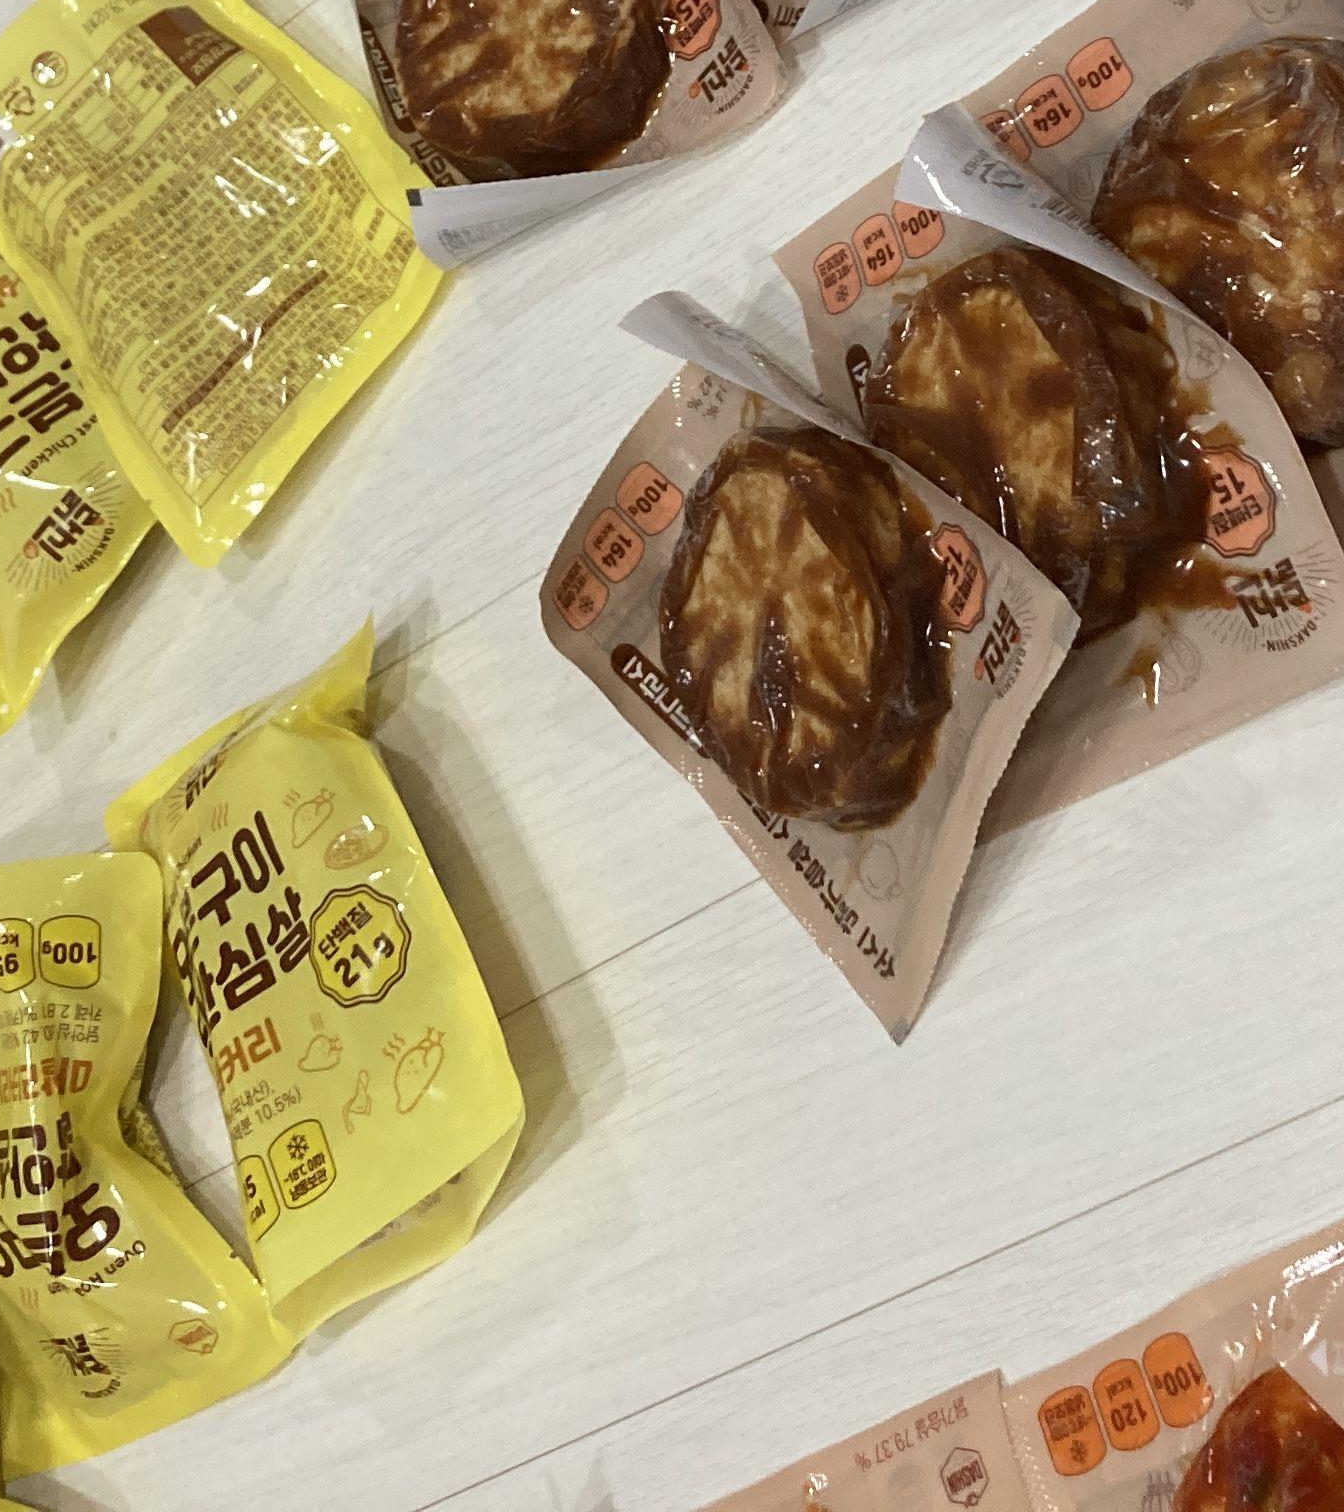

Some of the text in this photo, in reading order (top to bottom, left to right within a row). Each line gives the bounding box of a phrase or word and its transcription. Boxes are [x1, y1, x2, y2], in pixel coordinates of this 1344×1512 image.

[697, 35, 748, 103] 닭신
[1075, 53, 1124, 90] 100g
[1076, 54, 1122, 89] 100g
[1030, 100, 1073, 135] 164
[861, 227, 886, 250] kcal
[899, 207, 939, 235] 100g
[864, 242, 896, 272] 164
[18, 431, 77, 480] Chicken
[626, 475, 670, 517] 100g
[1206, 494, 1262, 536] 단백질
[29, 486, 100, 566] 닭신
[599, 532, 633, 570] 164
[1231, 557, 1308, 628] 닭신
[977, 599, 1021, 684] 닭신
[1265, 619, 1315, 653] DAKSHIN
[783, 838, 905, 983] 소스 닭가슴살
[313, 901, 373, 962] 단백질
[40, 940, 97, 965] 100g
[254, 1088, 305, 1126] 10.5%)
[101, 1238, 145, 1278] Oven
[1102, 1373, 1135, 1401] kcal
[1149, 1360, 1202, 1398] 100g
[851, 1396, 970, 1472] 닭가슴살 79.37 %
[1106, 1396, 1148, 1435] 120
